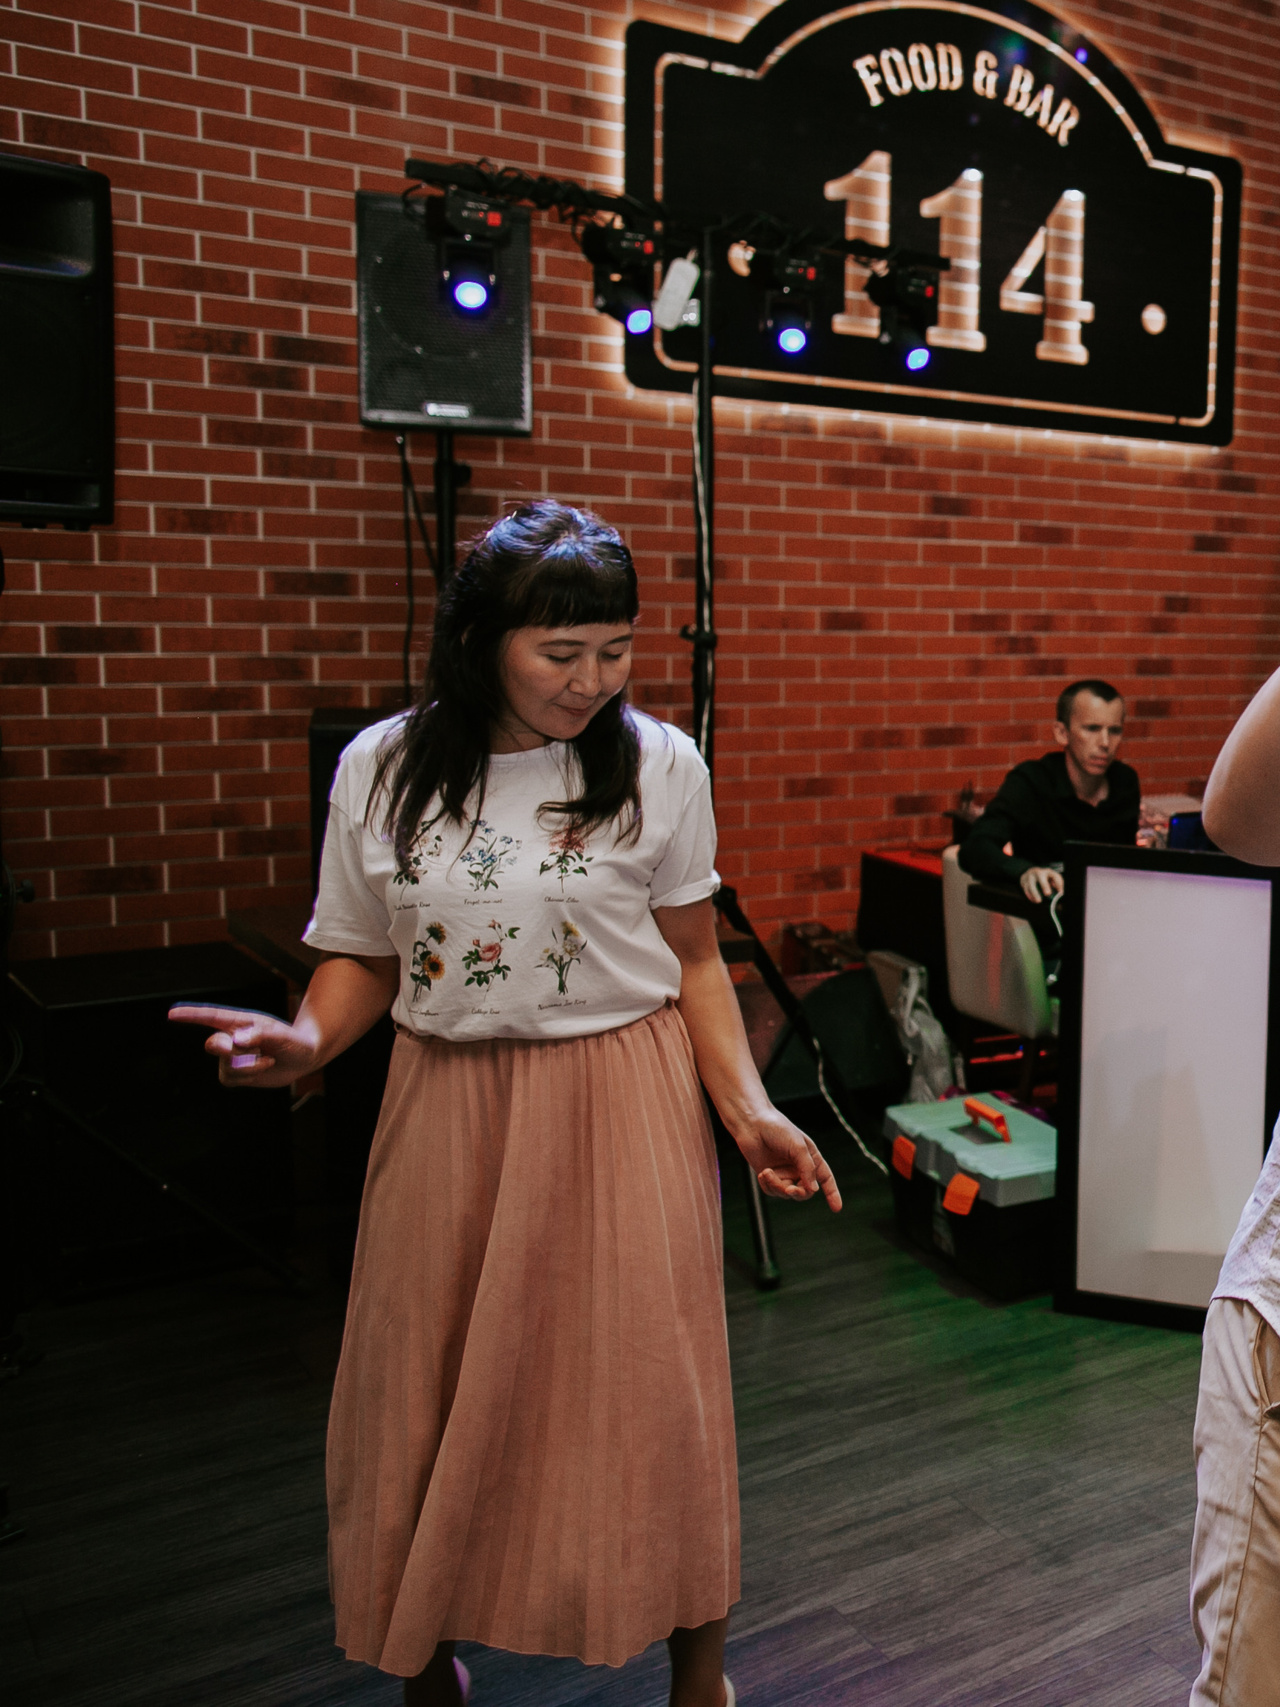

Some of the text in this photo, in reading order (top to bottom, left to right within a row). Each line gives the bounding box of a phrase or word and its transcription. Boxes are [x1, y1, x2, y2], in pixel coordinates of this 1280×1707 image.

[853, 43, 1080, 146] FOOD & BAR
[824, 150, 1095, 365] 114
